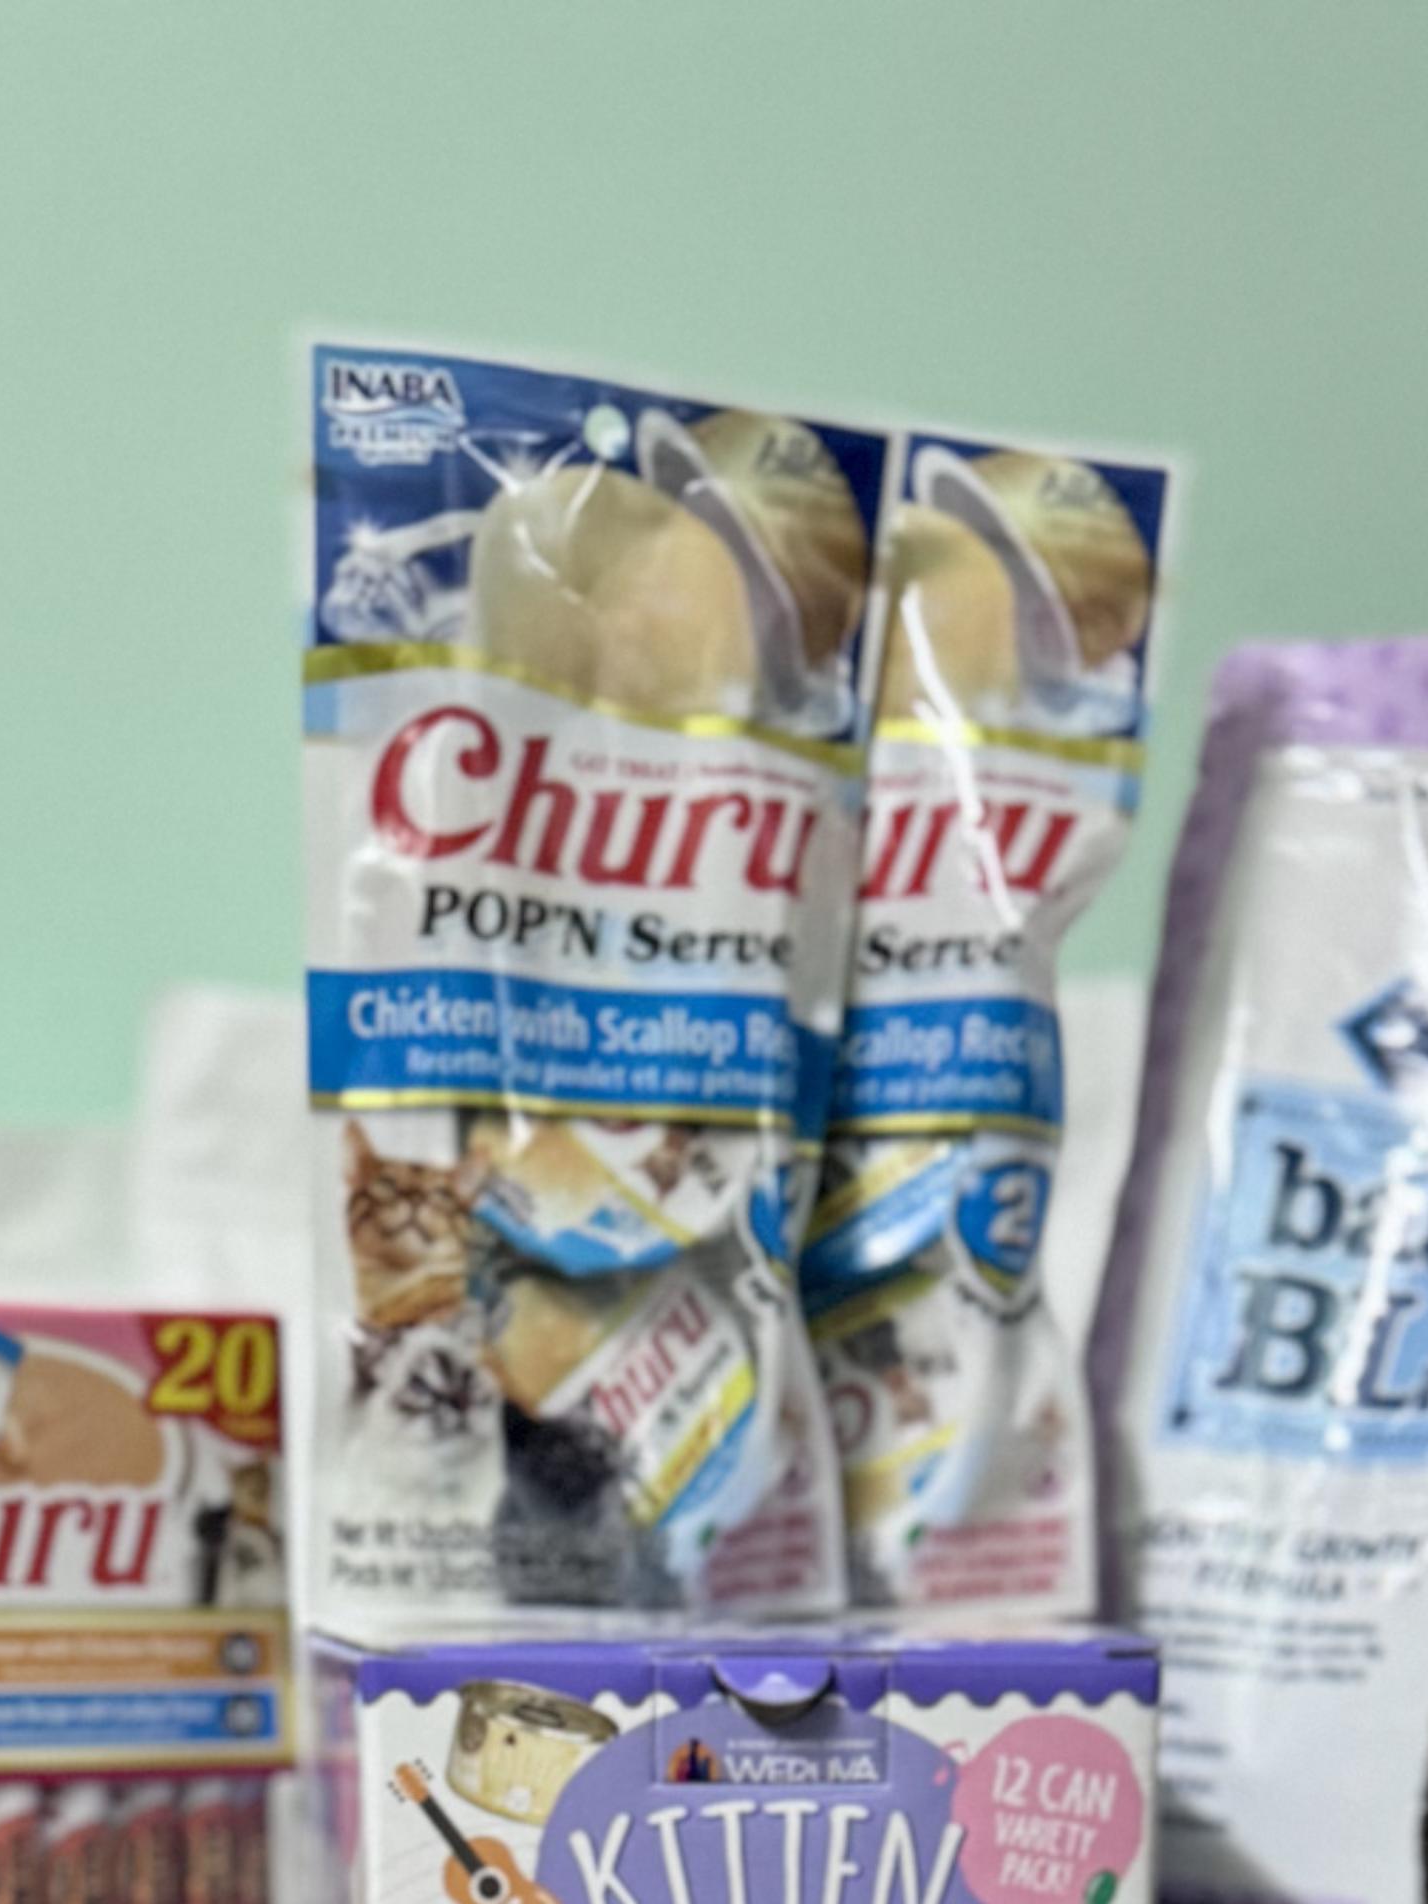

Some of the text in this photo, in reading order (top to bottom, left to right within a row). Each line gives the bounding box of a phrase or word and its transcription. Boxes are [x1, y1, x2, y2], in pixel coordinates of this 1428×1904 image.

[331, 366, 454, 405] INABA
[372, 706, 820, 899] Churu
[625, 912, 795, 966] Serve
[859, 922, 1025, 975] Serve
[348, 986, 497, 1040] Chicken
[596, 1007, 738, 1065] Scallop
[148, 1318, 277, 1414] 20
[992, 1754, 1118, 1823] 12 CAN
[994, 1810, 1098, 1860] VARIETY
